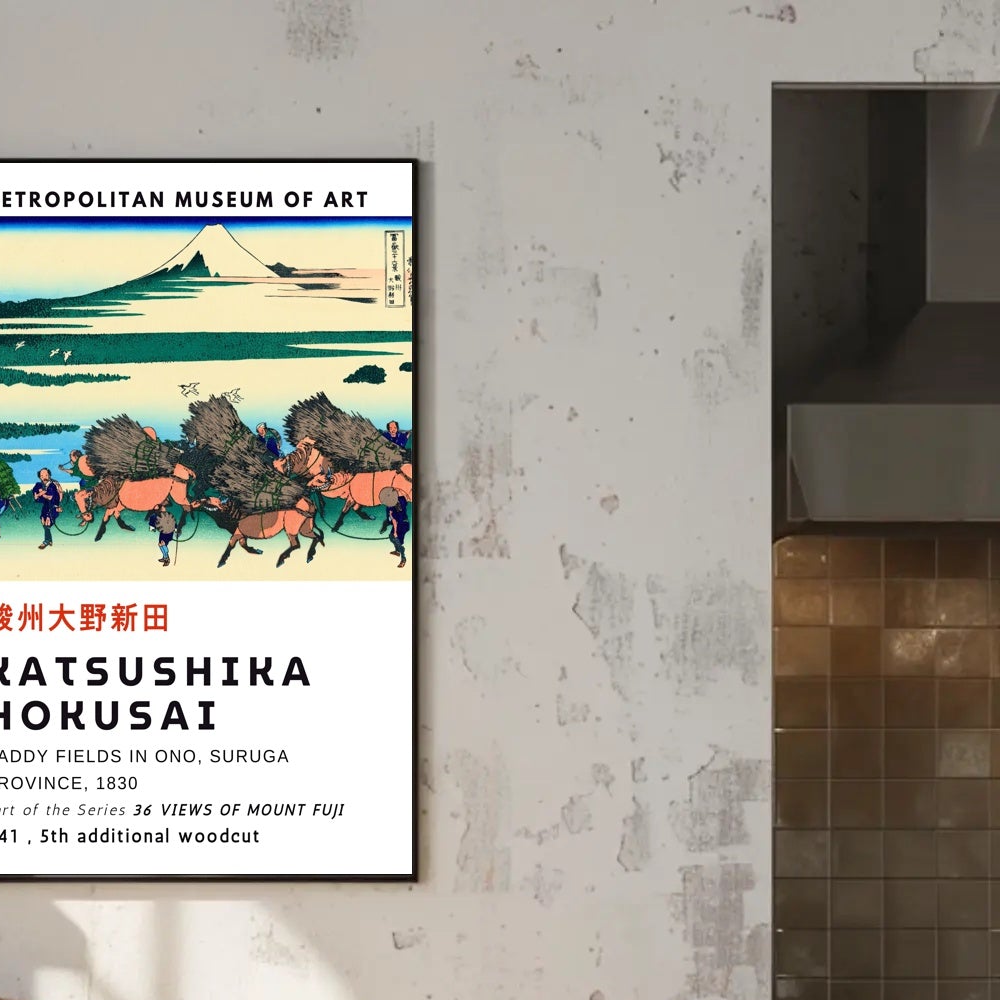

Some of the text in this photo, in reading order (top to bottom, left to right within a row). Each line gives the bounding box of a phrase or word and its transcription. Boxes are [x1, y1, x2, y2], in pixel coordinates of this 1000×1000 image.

[175, 191, 273, 207] MUSEUM
[284, 191, 313, 207] OF
[323, 191, 368, 207] ART
[56, 749, 122, 763] FIELDS
[130, 749, 147, 763] IN
[155, 749, 202, 765] ONO,
[210, 749, 289, 763] SURUGA
[96, 776, 138, 790] 1830
[22, 803, 40, 816] of
[46, 803, 71, 816] the
[77, 803, 126, 816] Series
[133, 803, 153, 817] 36
[161, 803, 213, 817] VIEWS
[219, 803, 242, 817] OF
[247, 803, 307, 817] MOUNT
[312, 803, 345, 819] FUJI
[39, 827, 68, 844] 5th
[77, 827, 169, 844] additional
[178, 827, 260, 844] woodcut
